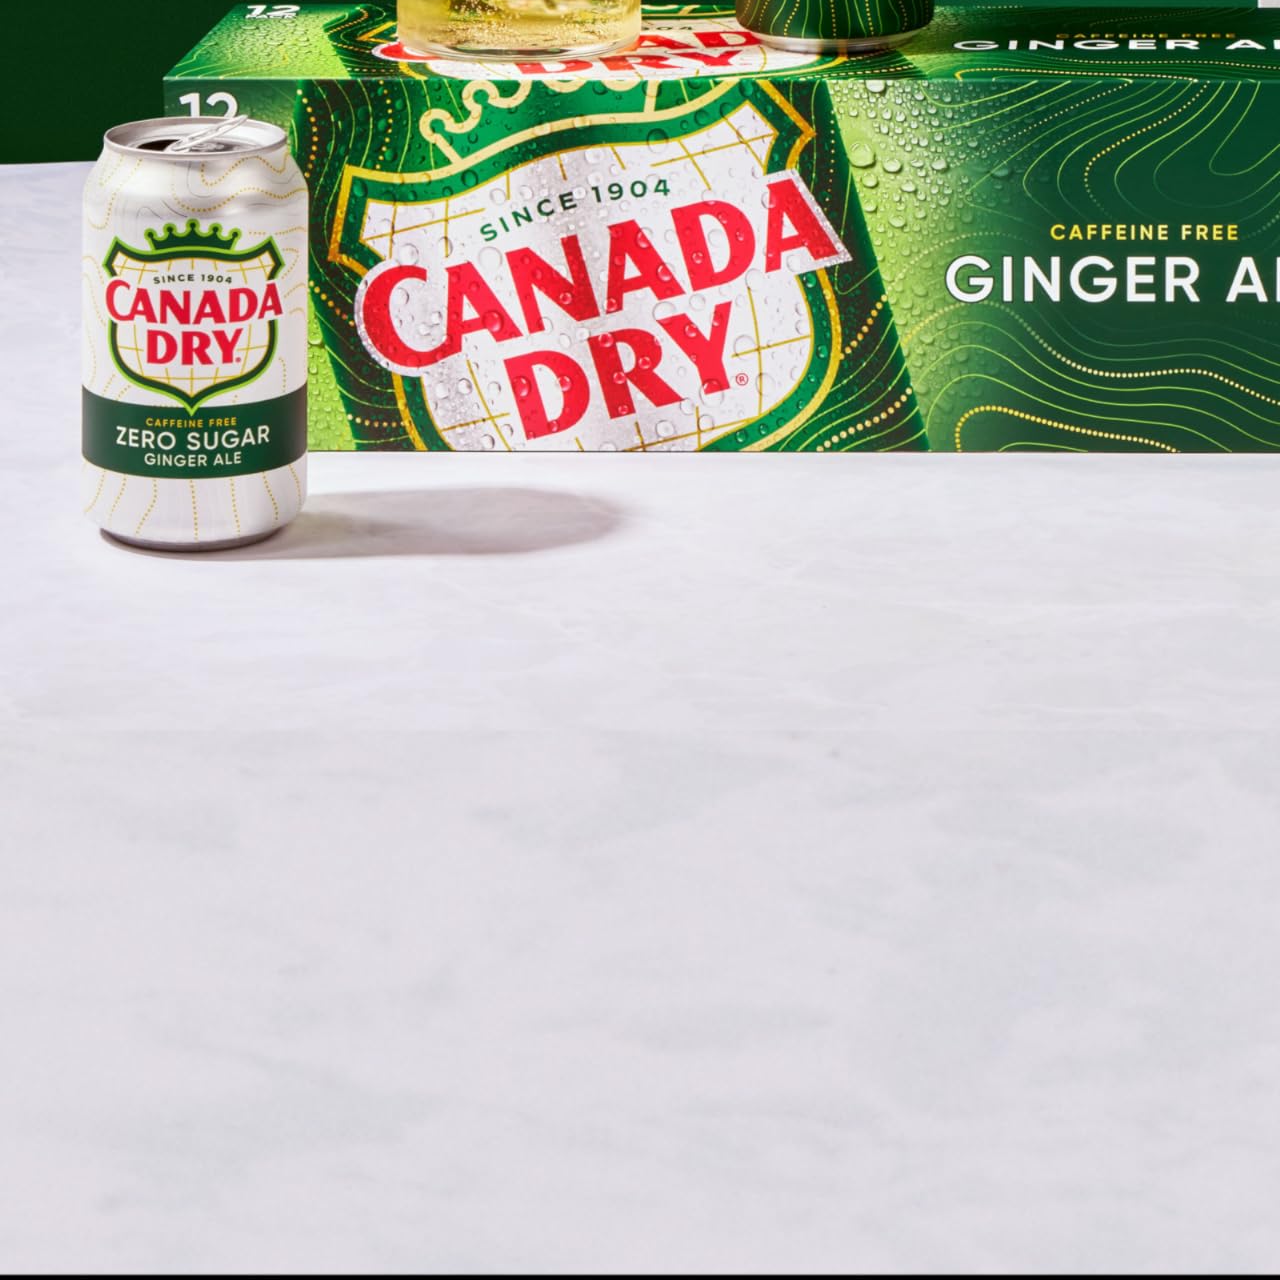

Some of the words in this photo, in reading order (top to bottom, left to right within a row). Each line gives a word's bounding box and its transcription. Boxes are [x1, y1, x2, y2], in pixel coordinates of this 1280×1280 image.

[247, 5, 300, 18] 12
[953, 39, 1200, 52] GINGER
[179, 92, 237, 118] 12
[479, 189, 579, 242] SINCE
[591, 177, 672, 204] 1904
[1049, 223, 1170, 241] CAFFEINE
[1181, 223, 1239, 241] FREE
[153, 273, 195, 285] SINCE
[200, 273, 233, 285] 1904
[361, 176, 842, 369] CANADA
[945, 254, 1201, 303] GINGER
[105, 279, 284, 325] CANADA
[146, 327, 244, 366] DRY
[145, 417, 204, 429] CAFFEINE
[208, 416, 238, 427] FREE
[115, 425, 176, 451] ZERO
[186, 424, 270, 451] SUGAR
[144, 452, 207, 467] GINGER
[213, 451, 242, 466] ALE
